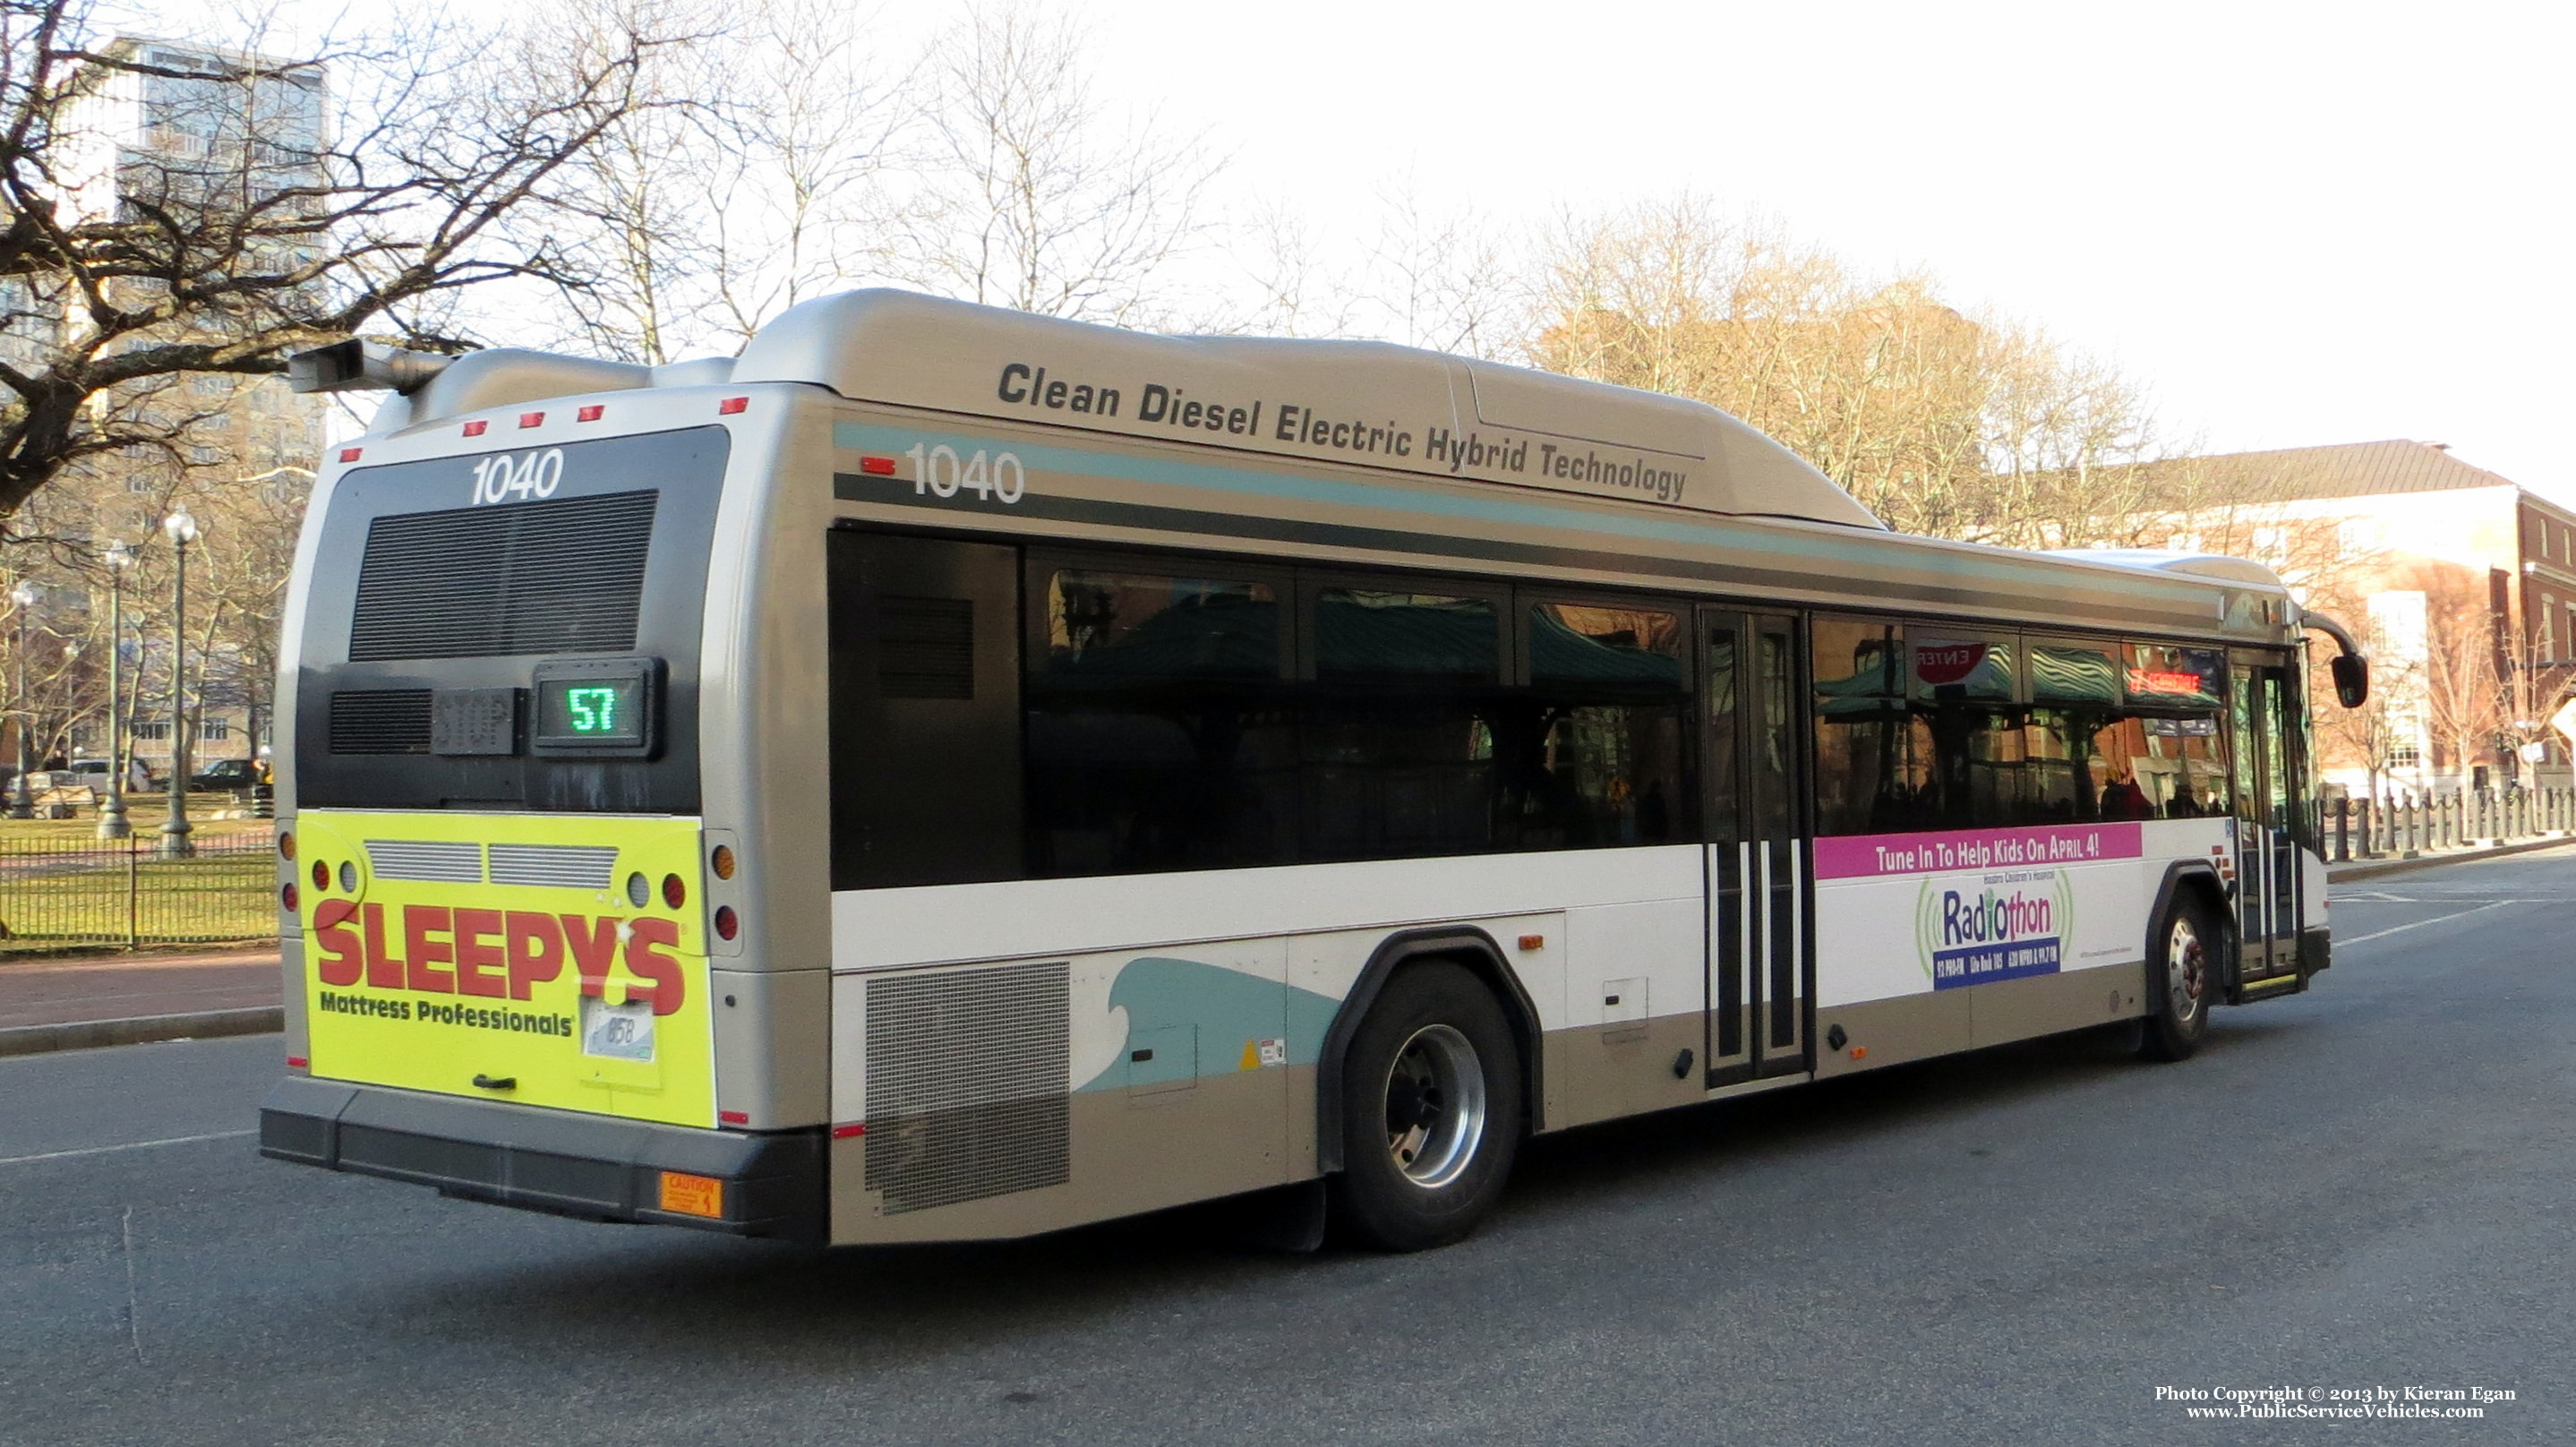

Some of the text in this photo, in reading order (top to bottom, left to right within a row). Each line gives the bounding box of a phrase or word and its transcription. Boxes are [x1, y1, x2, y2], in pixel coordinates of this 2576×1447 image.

[998, 363, 1687, 504] Clean Diesel Electric Hybrid Technology
[471, 448, 564, 505] 1040
[906, 441, 1025, 504] 1040
[568, 687, 616, 732] 57
[1876, 832, 2099, 872] Tune In To Help Kids On APRIL 4!
[1944, 887, 2050, 946] Radiothon
[320, 991, 574, 1038] Mattress Professionals
